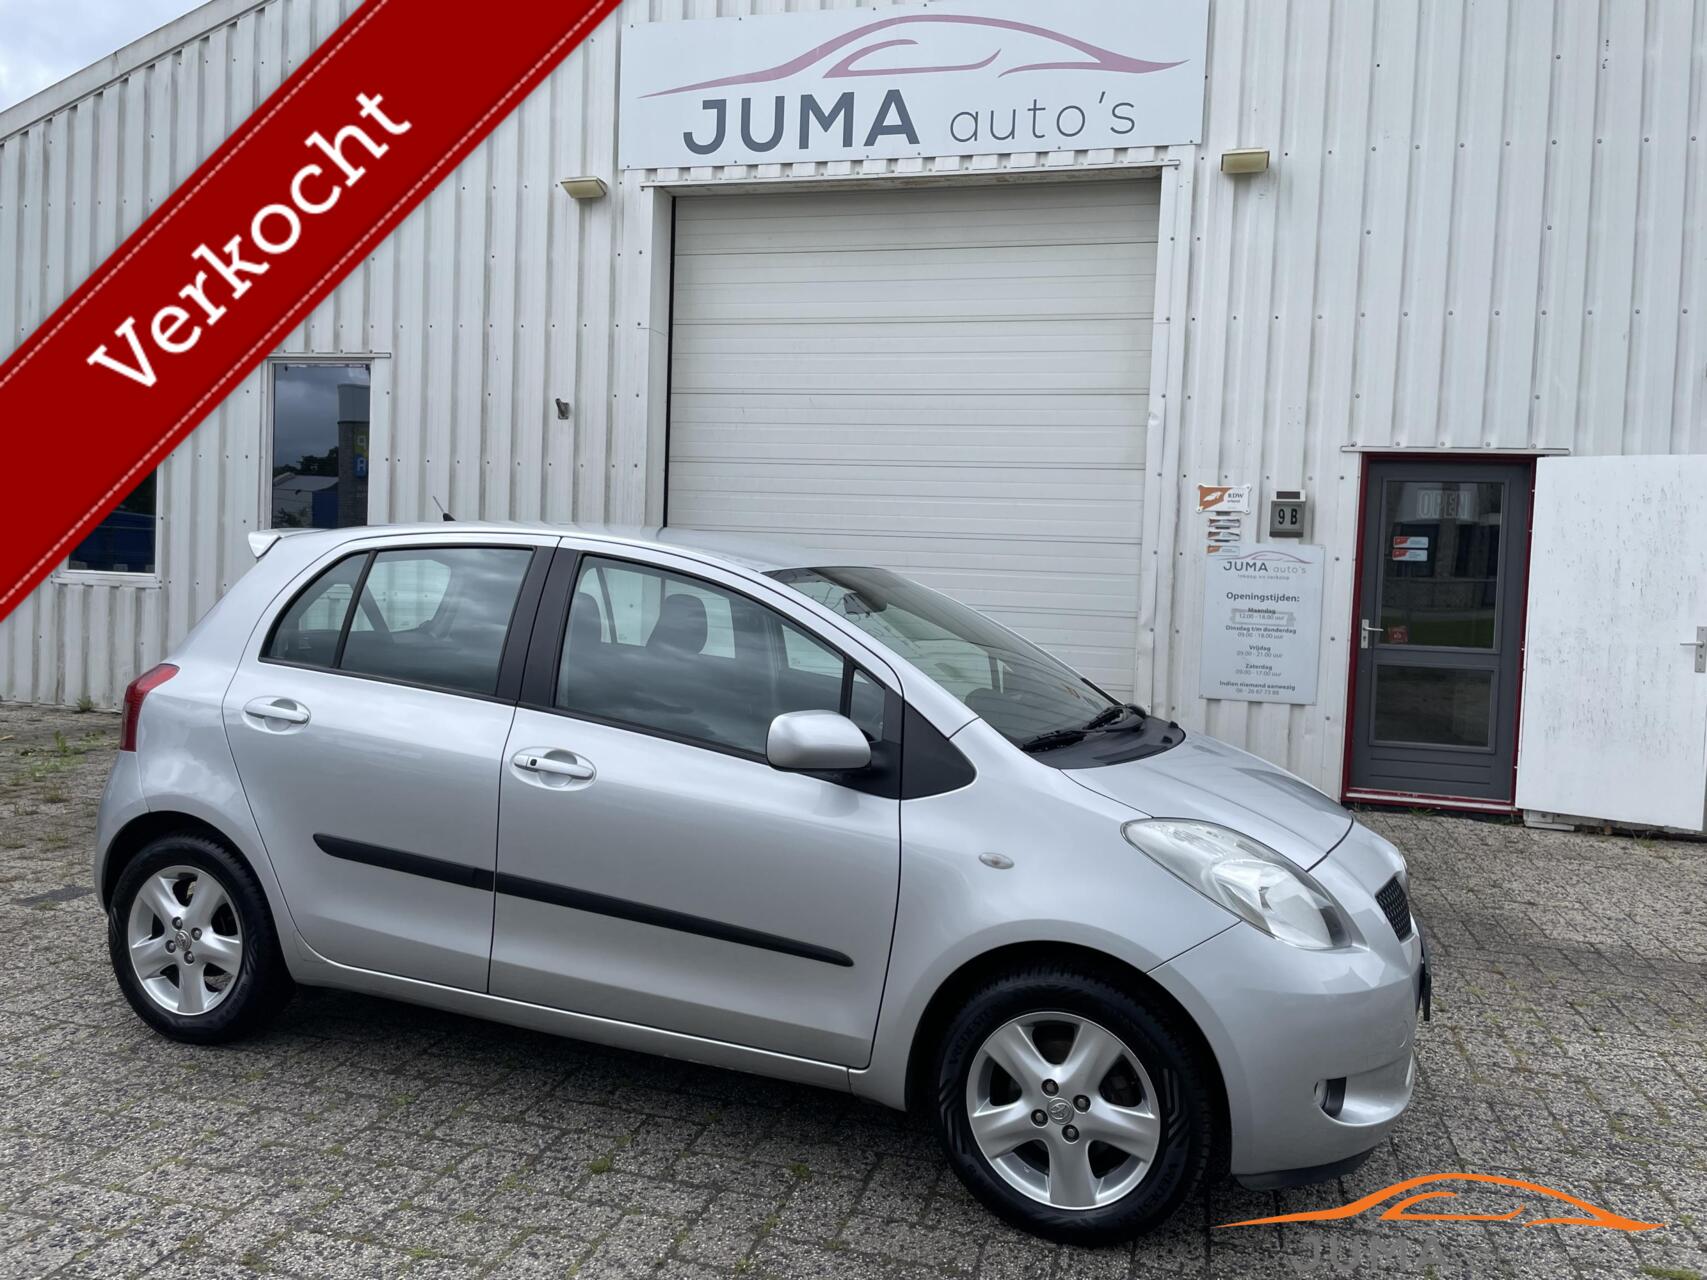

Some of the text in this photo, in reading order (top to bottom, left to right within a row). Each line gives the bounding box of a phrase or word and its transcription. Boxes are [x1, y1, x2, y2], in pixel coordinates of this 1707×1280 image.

[683, 88, 1136, 155] JUMA auto's
[1418, 490, 1471, 518] OPEN
[1278, 508, 1298, 525] 9 B
[1223, 560, 1307, 574] JUMA auto's
[1226, 591, 1300, 603] Openingstijden:
[1247, 607, 1276, 615] Maandag
[1225, 624, 1251, 632] Dinsdag
[1262, 626, 1297, 635] donderdag
[1248, 644, 1271, 652] Vrijdag
[1245, 663, 1273, 671] Zaterdag
